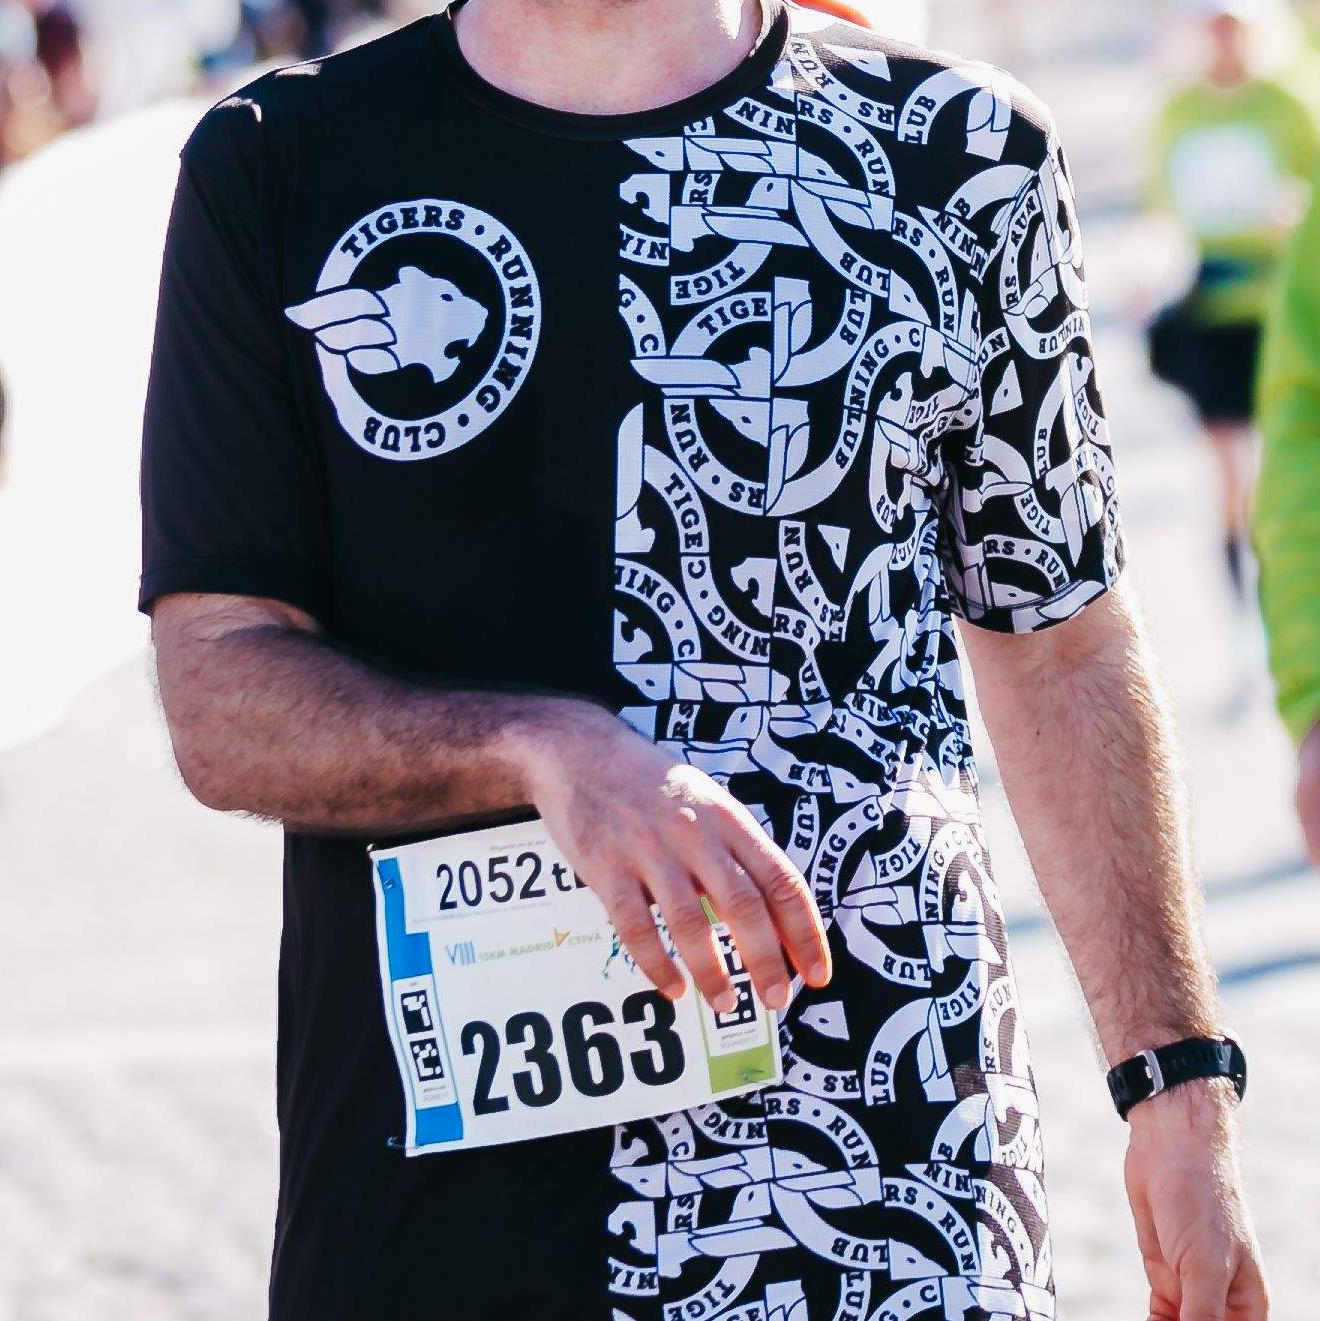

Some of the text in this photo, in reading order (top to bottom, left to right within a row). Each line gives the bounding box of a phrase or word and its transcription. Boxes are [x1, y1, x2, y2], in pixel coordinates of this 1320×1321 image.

[340, 205, 534, 452] TIGERS RUNNING CLUB
[459, 989, 686, 1117] 2363
